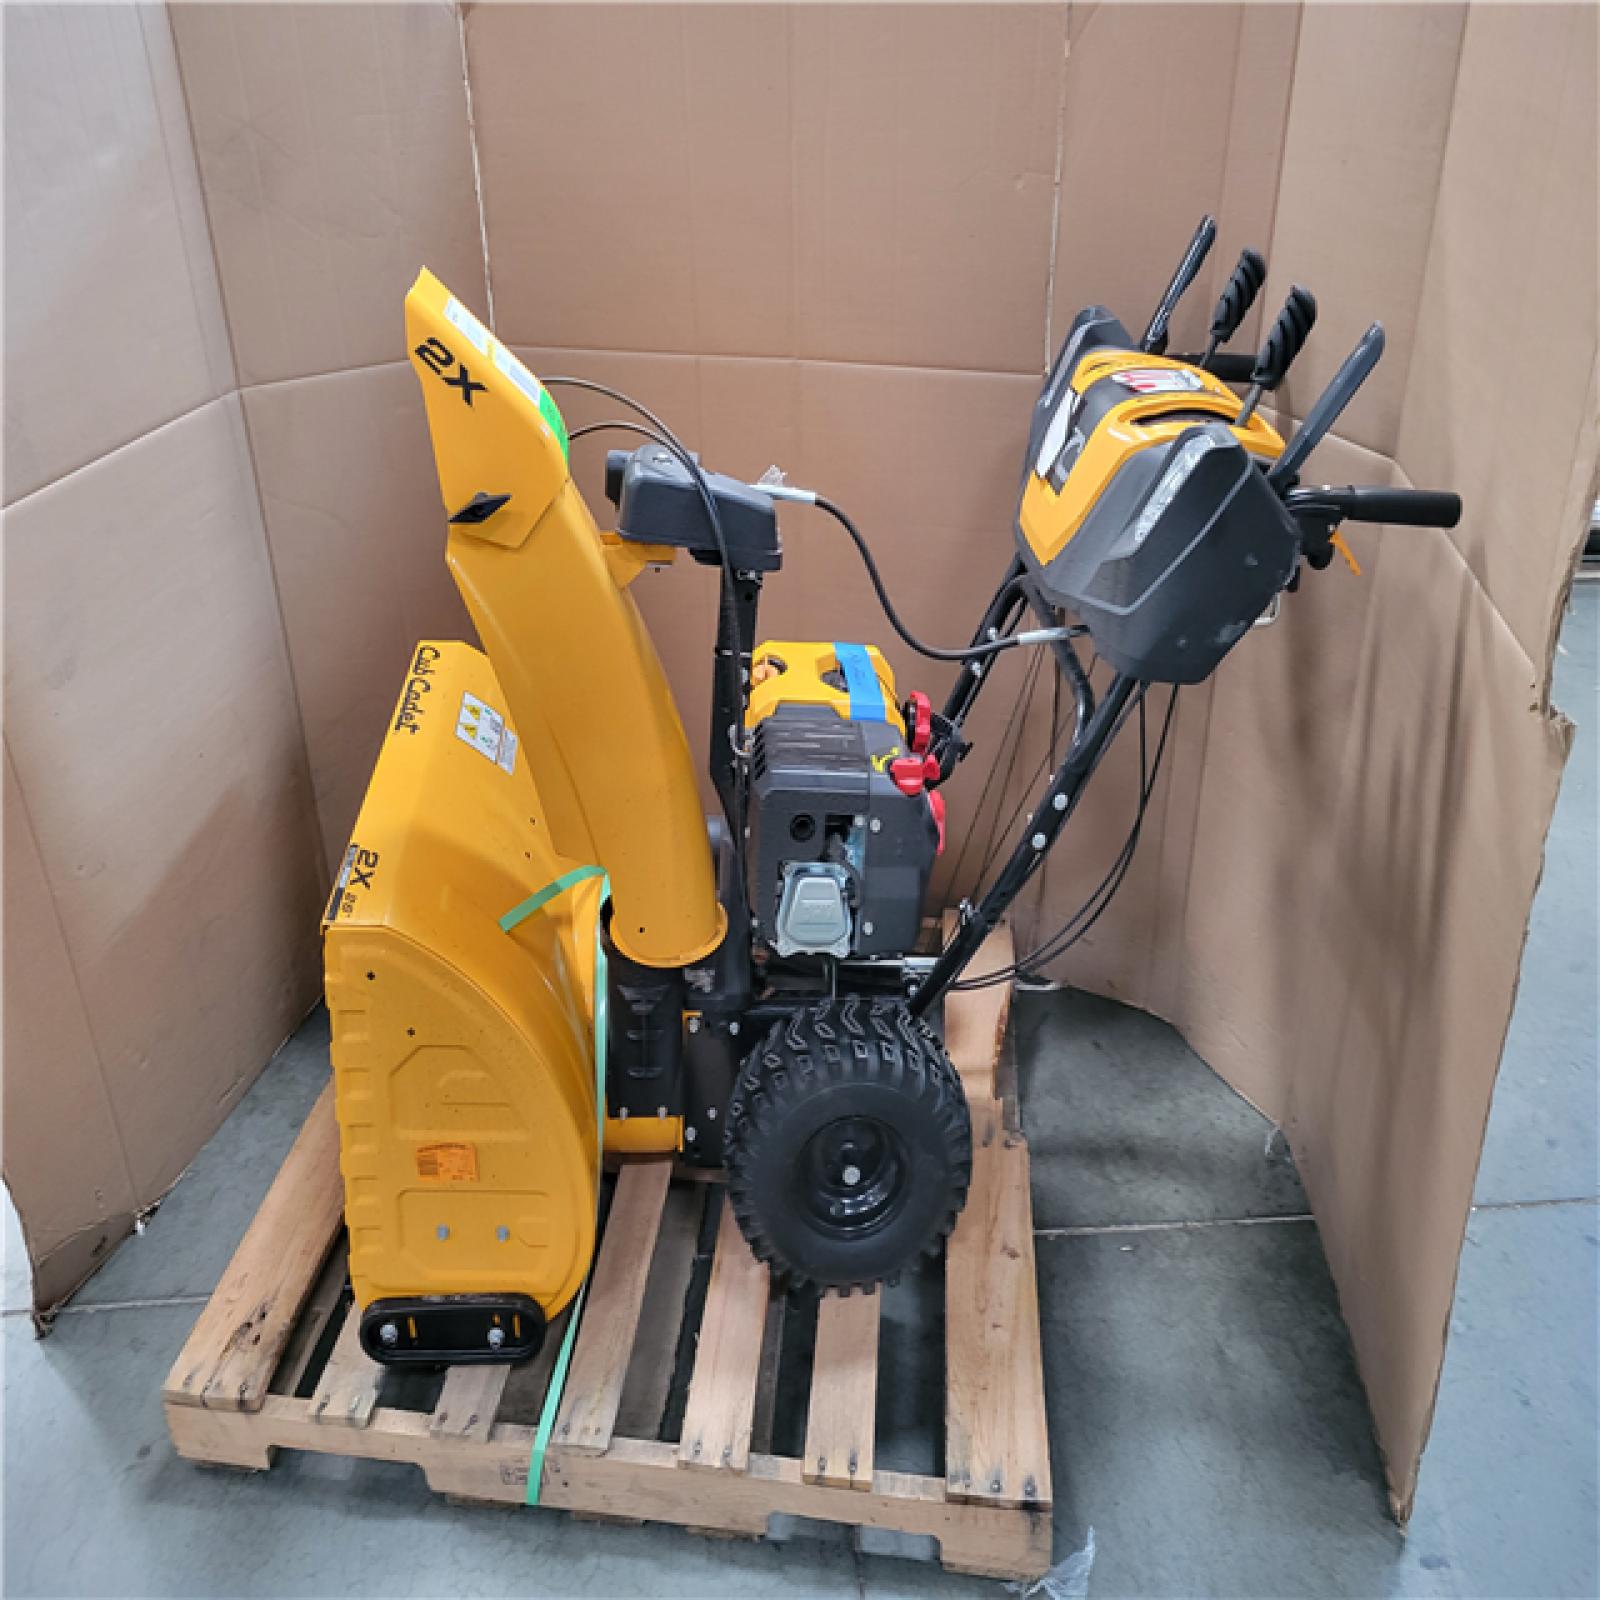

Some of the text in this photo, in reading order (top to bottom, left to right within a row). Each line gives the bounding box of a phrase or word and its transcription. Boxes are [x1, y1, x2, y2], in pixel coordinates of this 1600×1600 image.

[414, 337, 488, 408] 2X
[393, 645, 441, 735] Cub Cadet
[349, 849, 379, 891] 2X
